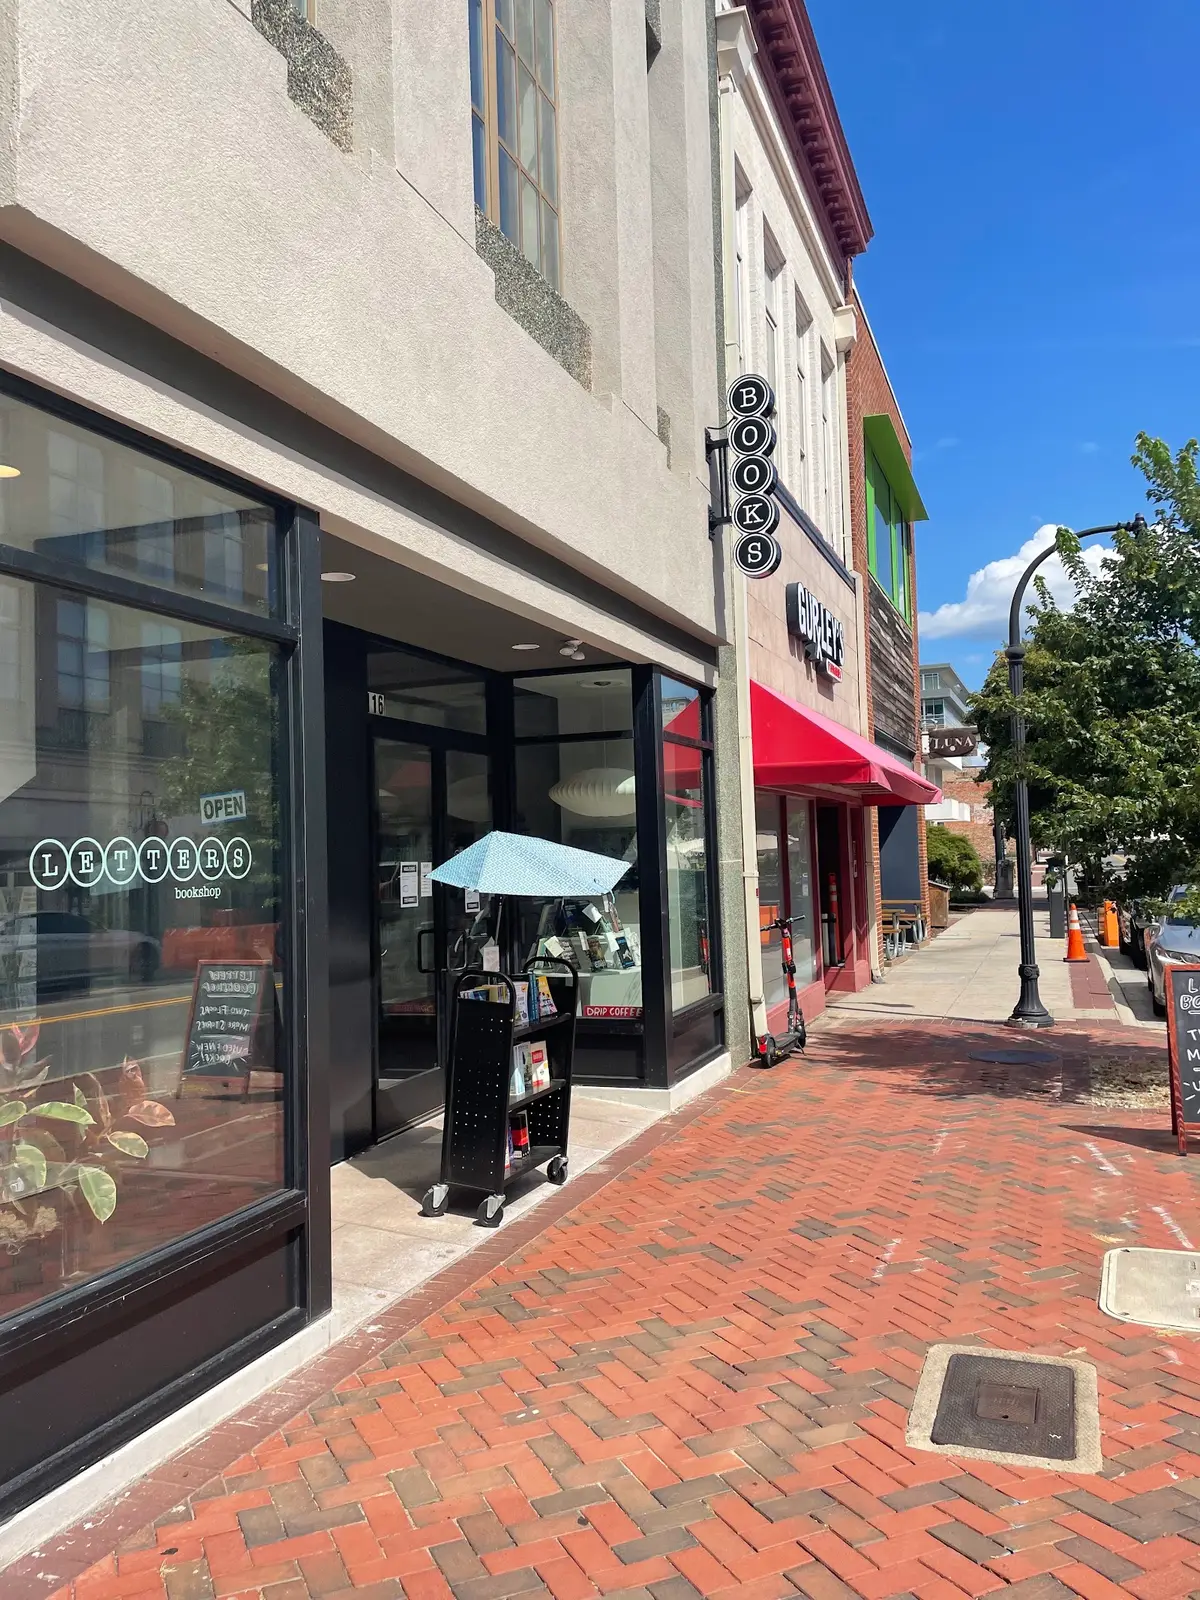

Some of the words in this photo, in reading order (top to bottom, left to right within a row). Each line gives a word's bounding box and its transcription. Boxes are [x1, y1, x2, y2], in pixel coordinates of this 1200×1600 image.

[737, 384, 765, 566] BOOKS
[797, 582, 845, 667] GURLEY'S
[933, 736, 975, 749] LUNA
[203, 795, 244, 820] OPEN
[39, 846, 245, 878] LETTERS
[175, 886, 221, 899] bookshop
[586, 1007, 608, 1017] DRIP
[609, 1007, 642, 1017] COFFEE
